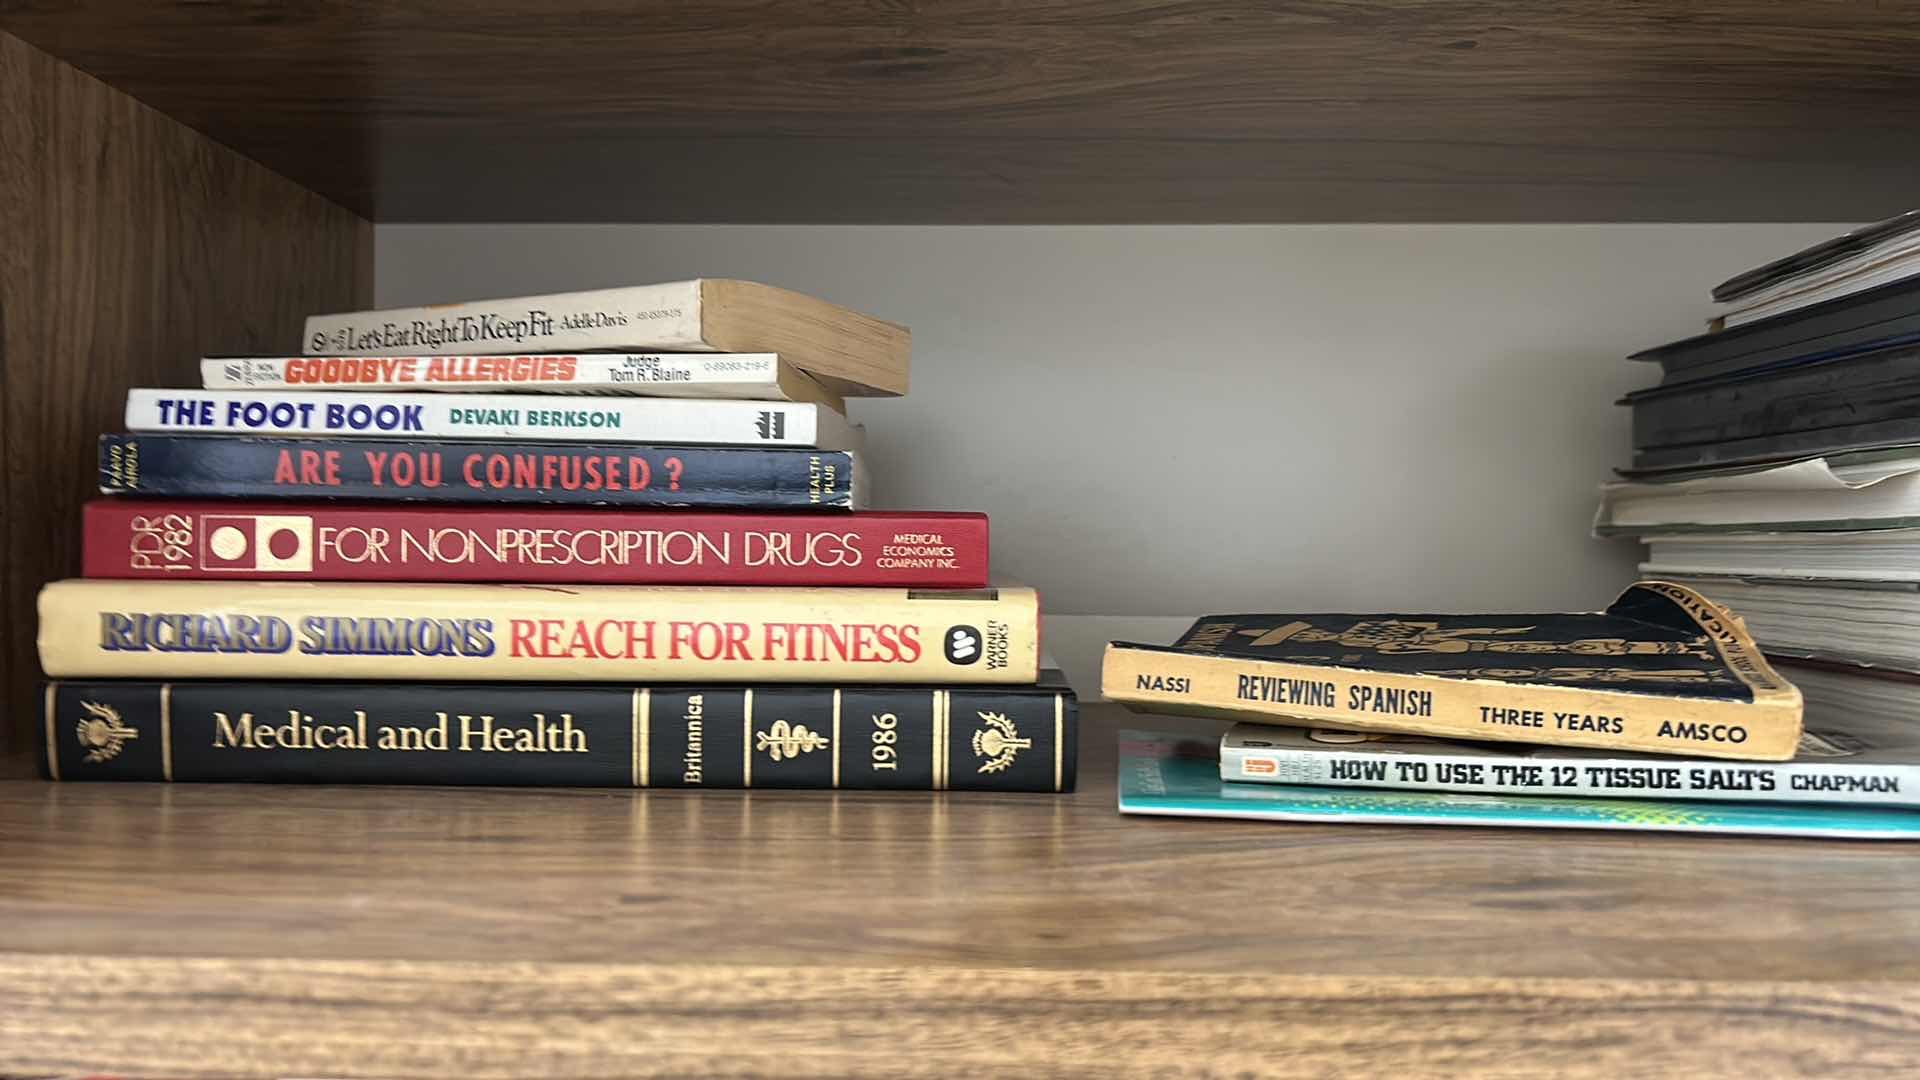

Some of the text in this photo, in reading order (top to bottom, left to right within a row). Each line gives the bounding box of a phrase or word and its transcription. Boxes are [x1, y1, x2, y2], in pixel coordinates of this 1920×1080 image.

[383, 323, 410, 348] Eat
[411, 317, 458, 349] Right
[457, 316, 479, 341] To
[480, 313, 528, 342] Keep
[528, 310, 555, 337] Fit
[284, 357, 418, 384] GOODBYE
[424, 356, 577, 383] ALLERGIES
[609, 368, 691, 382] Tom R. Blaine
[623, 355, 661, 369] Judge
[158, 399, 425, 431] THE FOOT BOOK
[449, 408, 621, 428] DEVAKI BERKSON
[273, 449, 685, 492] ARE YOU CONFUSED ?
[809, 456, 821, 503] HEALTH
[824, 465, 835, 494] PLUS
[130, 515, 164, 570] PDR
[163, 514, 194, 572] 1982
[318, 527, 862, 568] FOR NONPRESCRIPTION DRUGS
[883, 546, 955, 557] ECONOMICS
[893, 534, 943, 545] MEDICAL
[876, 558, 961, 569] COMPANY INC.
[99, 612, 922, 664] RICHARD SIMMONS REACH FOR FITNESS
[986, 620, 998, 671] WARNER
[997, 623, 1009, 668] BOOKS
[1136, 674, 1190, 694] NASSI
[1236, 674, 1433, 718] REVIEWING SPANISH
[212, 709, 589, 754] Medical and Health
[1480, 705, 1624, 735] THREE YEARS
[1657, 719, 1748, 744] AMSCO
[684, 694, 704, 784] Britannica
[871, 712, 898, 772] 1986
[1330, 759, 1388, 781] HOW
[1395, 761, 1428, 783] TO
[1436, 763, 1485, 785] USE
[1493, 764, 1543, 788] THE
[1552, 766, 1577, 788] 12
[1585, 767, 1682, 790] TISSUE
[1690, 769, 1776, 791] SALTS
[1790, 774, 1900, 793] CHAPMAN
